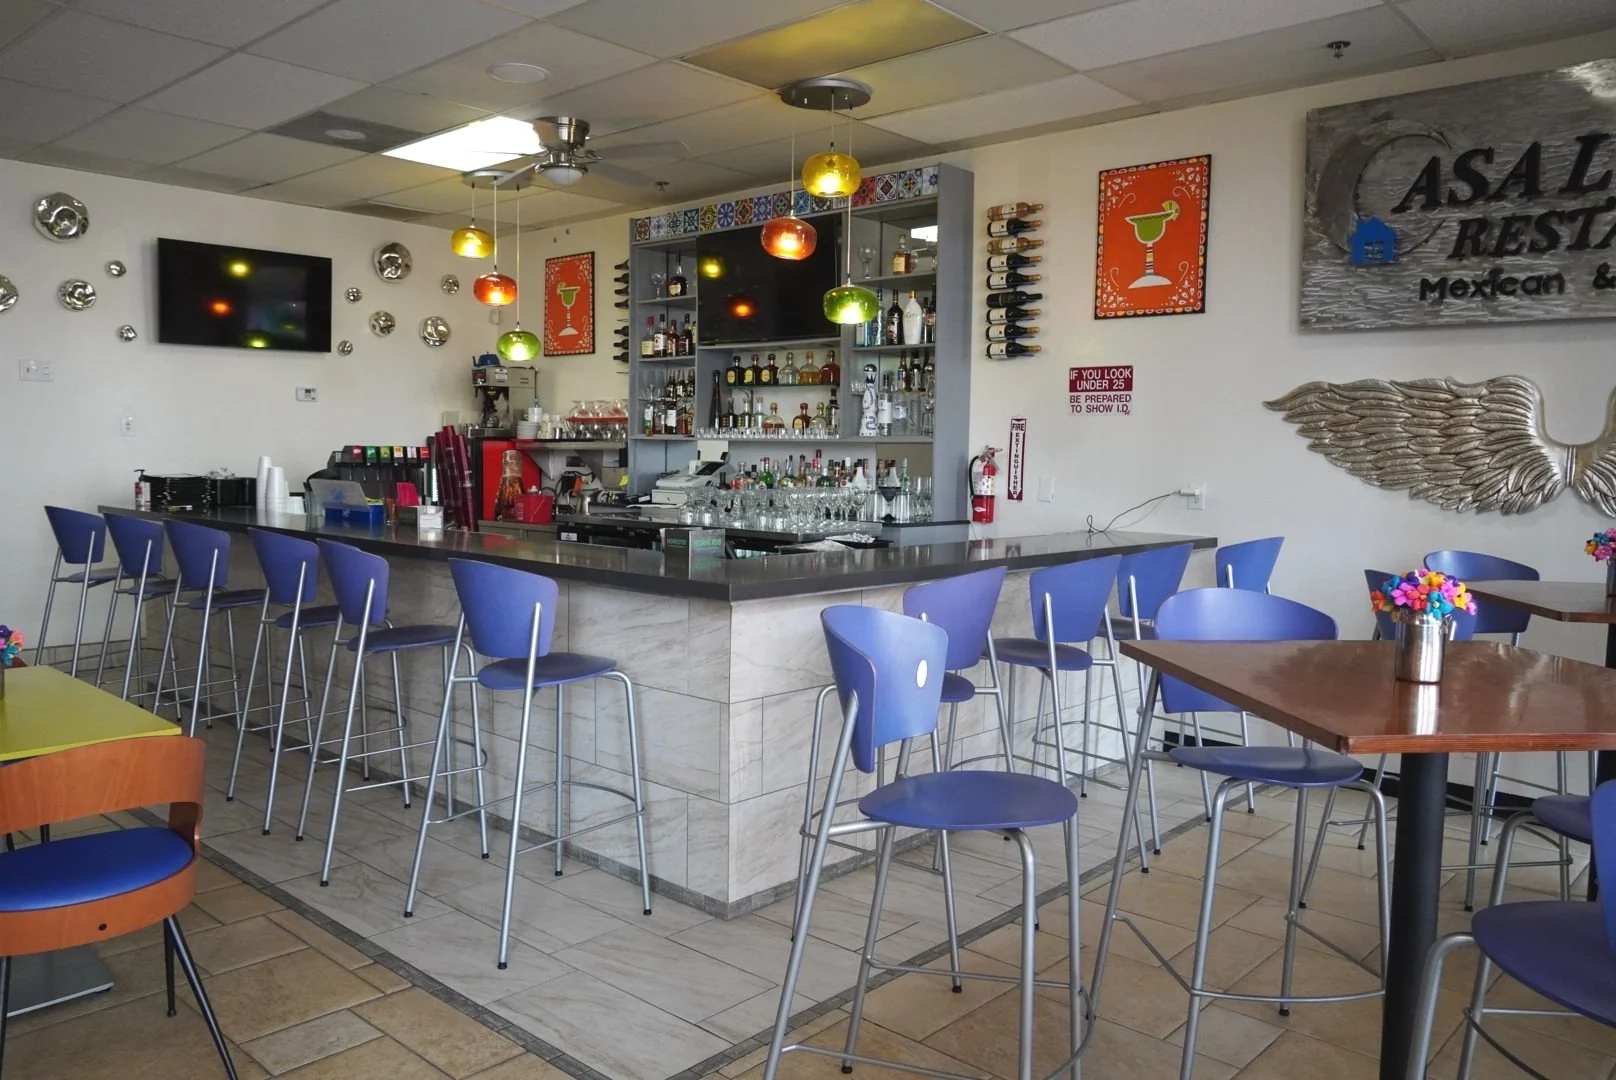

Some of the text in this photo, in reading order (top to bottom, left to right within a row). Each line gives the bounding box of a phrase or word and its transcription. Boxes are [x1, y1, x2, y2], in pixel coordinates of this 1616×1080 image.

[1447, 196, 1616, 259] REST
[1419, 262, 1616, 304] Mexican &
[1070, 368, 1132, 380] IF YOU LOOK
[1076, 379, 1125, 390] UNDER 25
[1069, 394, 1132, 404] BE PREPARED
[1070, 404, 1082, 413] TO
[1085, 404, 1113, 413] SHOW
[1012, 423, 1025, 431] FIRE
